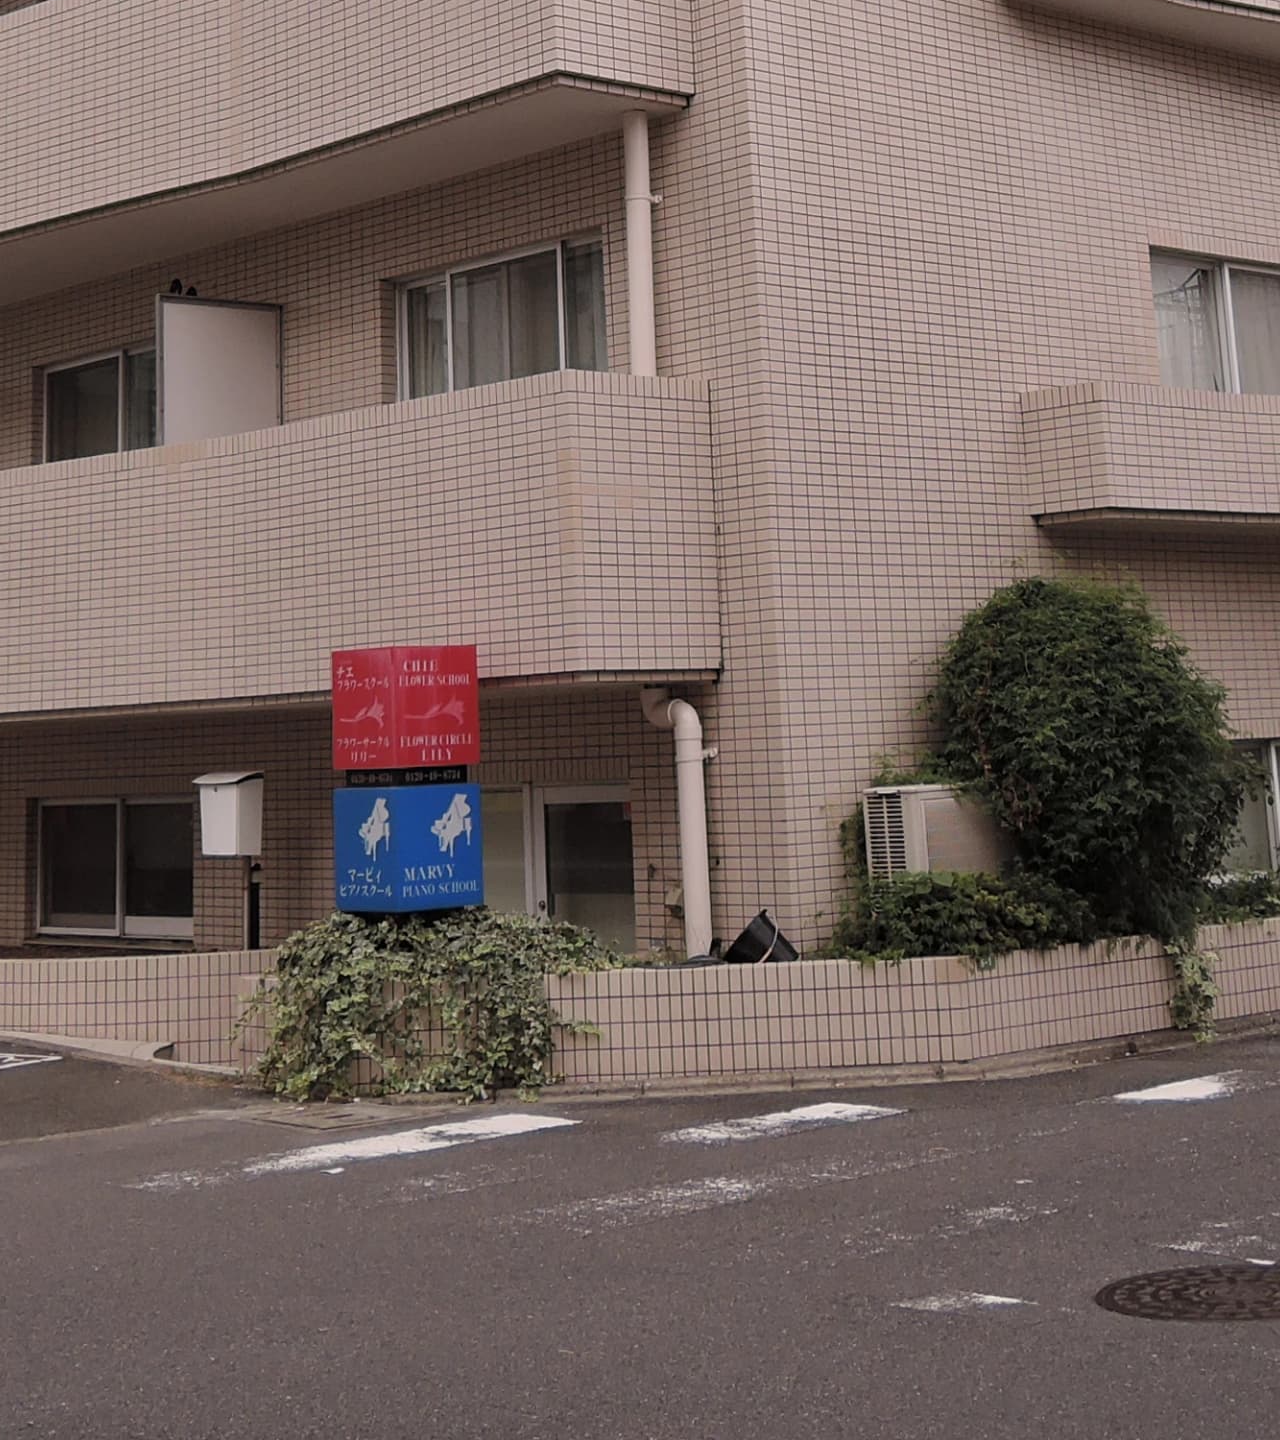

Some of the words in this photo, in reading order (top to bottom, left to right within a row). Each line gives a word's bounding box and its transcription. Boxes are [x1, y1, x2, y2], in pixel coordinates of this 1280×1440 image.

[336, 676, 390, 691] フラワースクール
[399, 674, 435, 688] FLOWER
[437, 673, 471, 686] SCHOOL
[400, 734, 438, 748] FLOWER
[421, 748, 453, 762] LILY
[404, 863, 456, 882] MARVY
[339, 883, 393, 898] ピアノスクール
[402, 884, 436, 899] PIANO
[438, 879, 480, 895] SCHOOL
